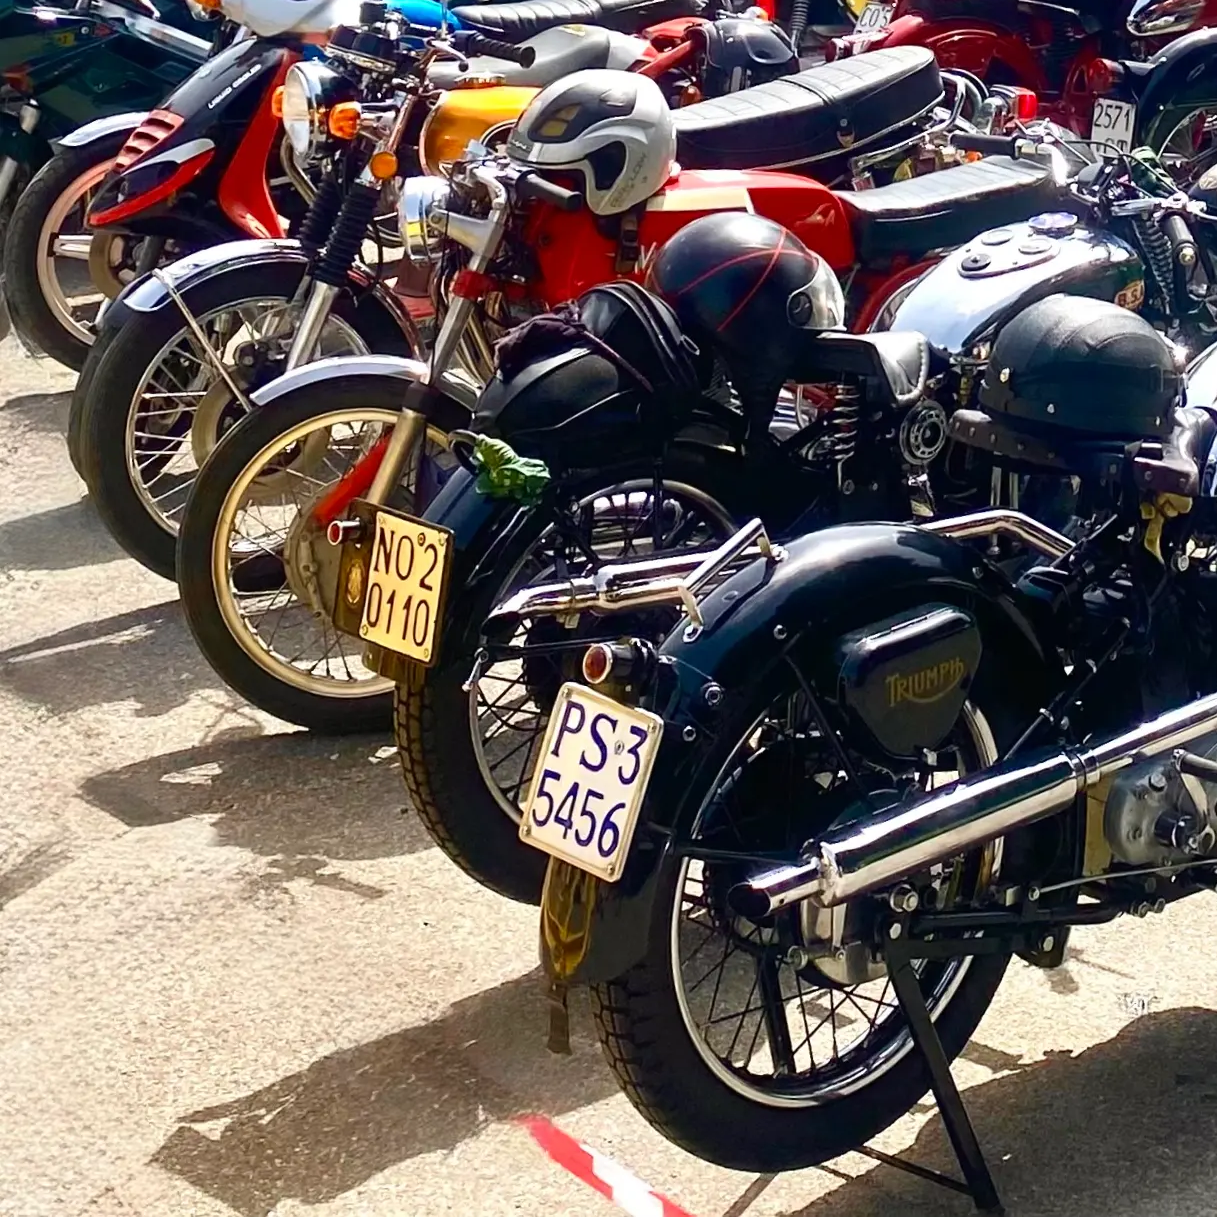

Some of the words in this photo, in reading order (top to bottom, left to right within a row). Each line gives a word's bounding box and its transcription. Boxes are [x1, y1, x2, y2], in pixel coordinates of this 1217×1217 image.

[1094, 103, 1130, 132] 2571
[366, 582, 430, 647] 0110
[884, 656, 965, 707] TRIUMPH
[532, 769, 626, 858] 5456
